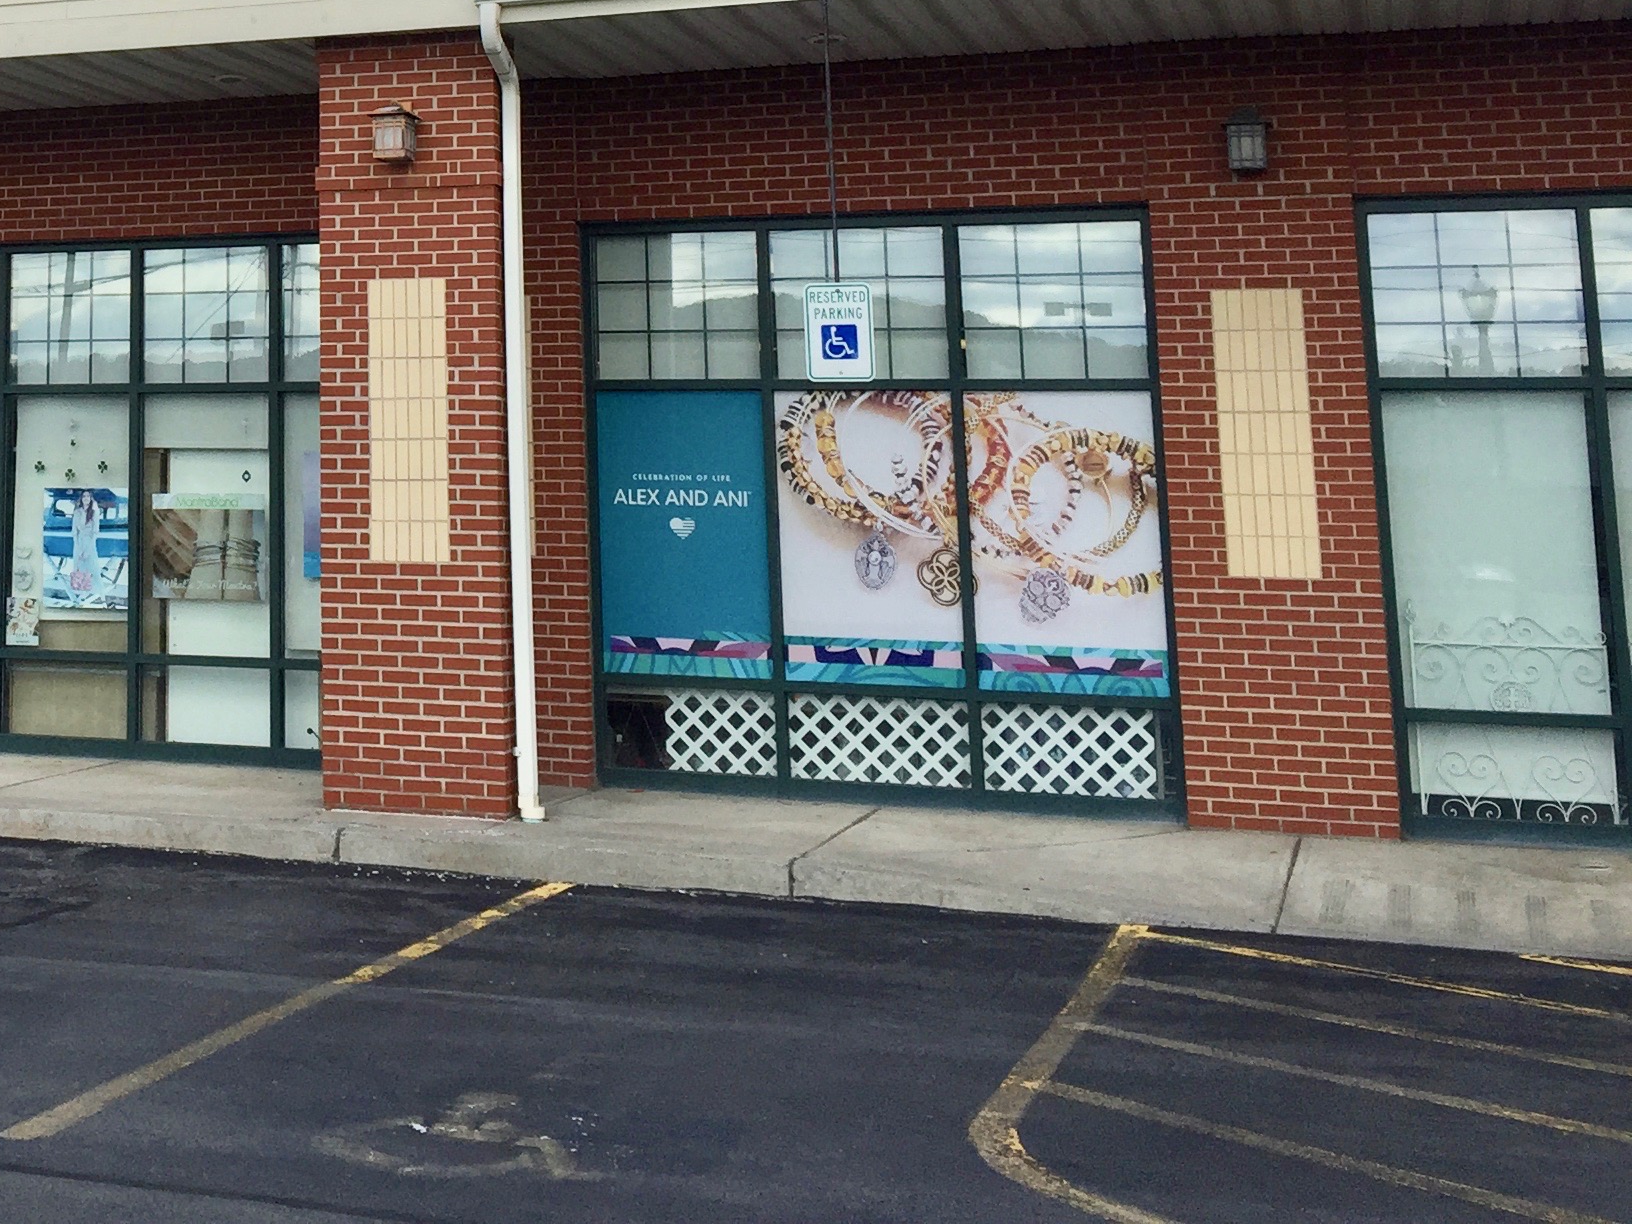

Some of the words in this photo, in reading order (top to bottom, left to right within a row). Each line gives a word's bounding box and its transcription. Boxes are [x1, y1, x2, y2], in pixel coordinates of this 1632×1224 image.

[809, 290, 866, 304] RESERVED
[814, 306, 863, 320] PARKING
[632, 473, 692, 482] CELEBRATION
[695, 474, 708, 482] OF
[711, 474, 731, 482] LIFE
[613, 488, 661, 506] ALEX
[664, 489, 709, 507] AND
